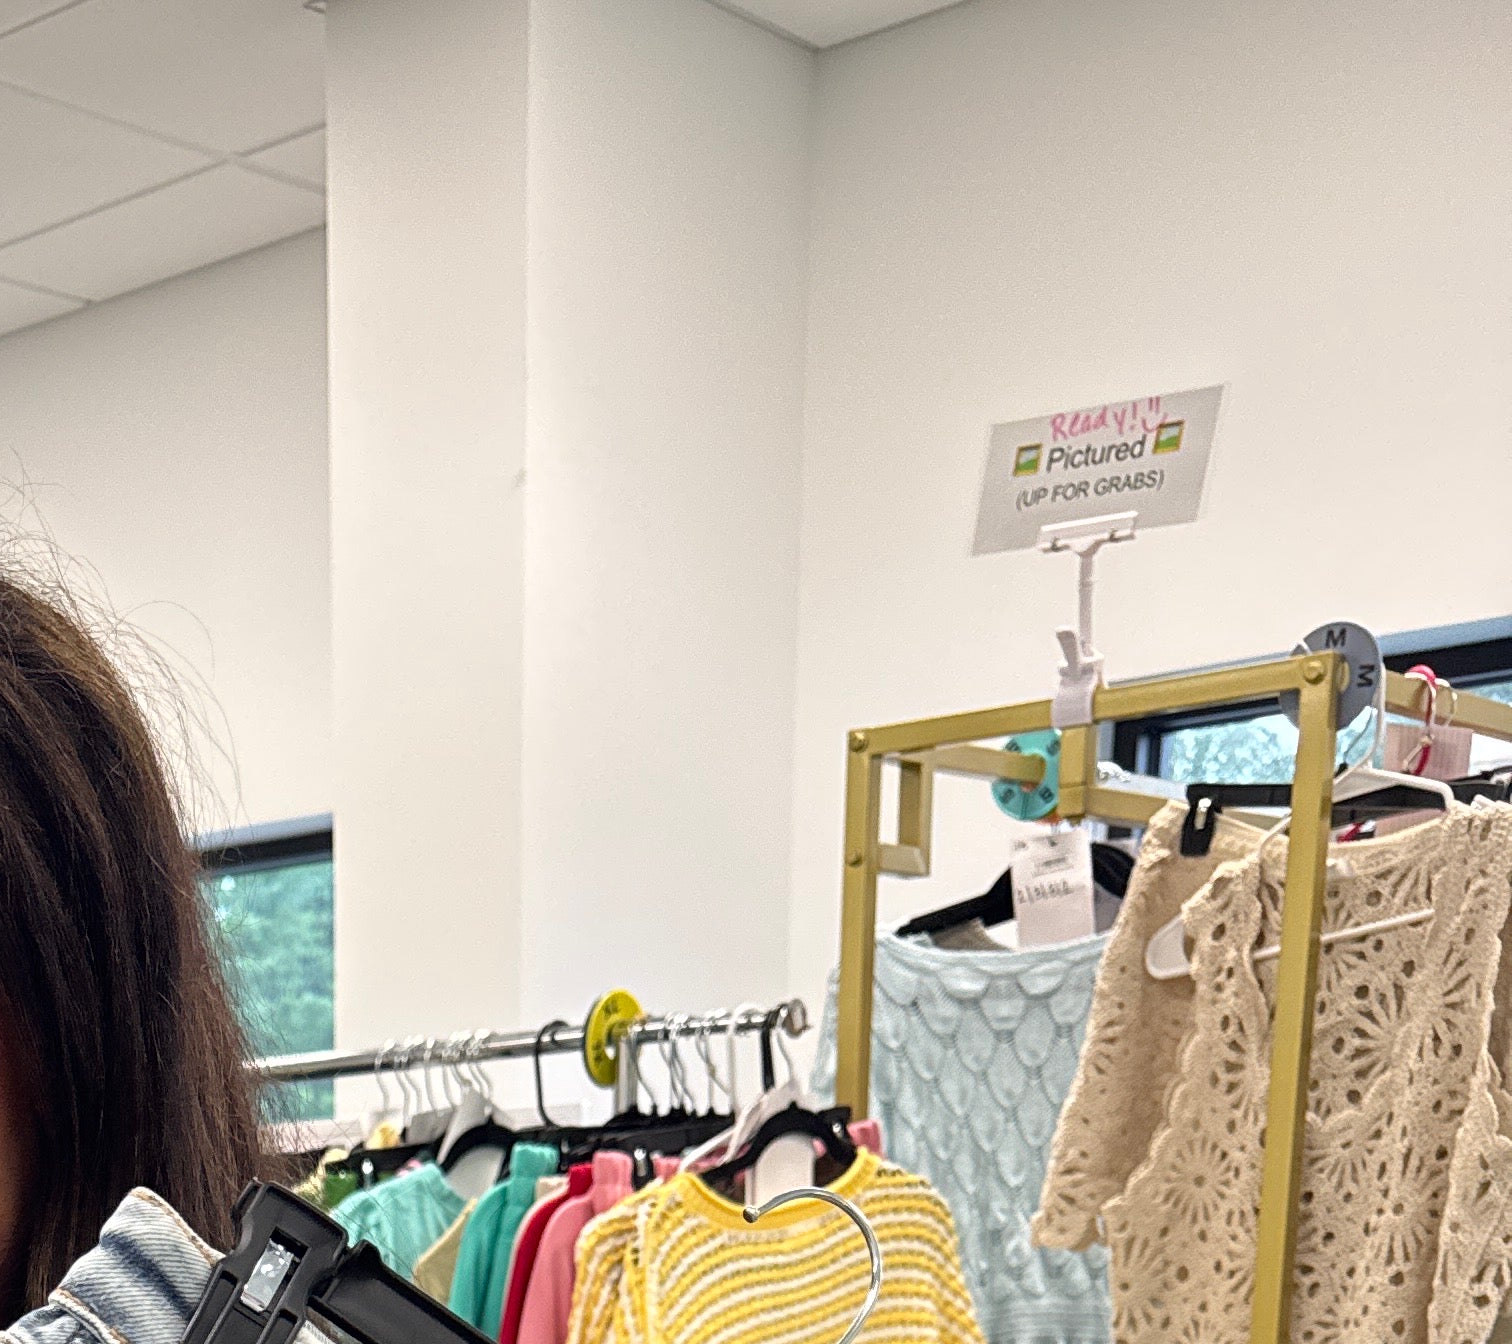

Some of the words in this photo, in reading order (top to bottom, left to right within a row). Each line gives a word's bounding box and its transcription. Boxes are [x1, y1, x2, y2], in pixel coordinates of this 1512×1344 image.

[1046, 434, 1147, 473] Pictured
[1016, 487, 1048, 511] (UP
[1051, 480, 1090, 502] FOR
[1093, 469, 1164, 496] GRABS)
[1325, 627, 1347, 648] M
[1357, 664, 1375, 688] M
